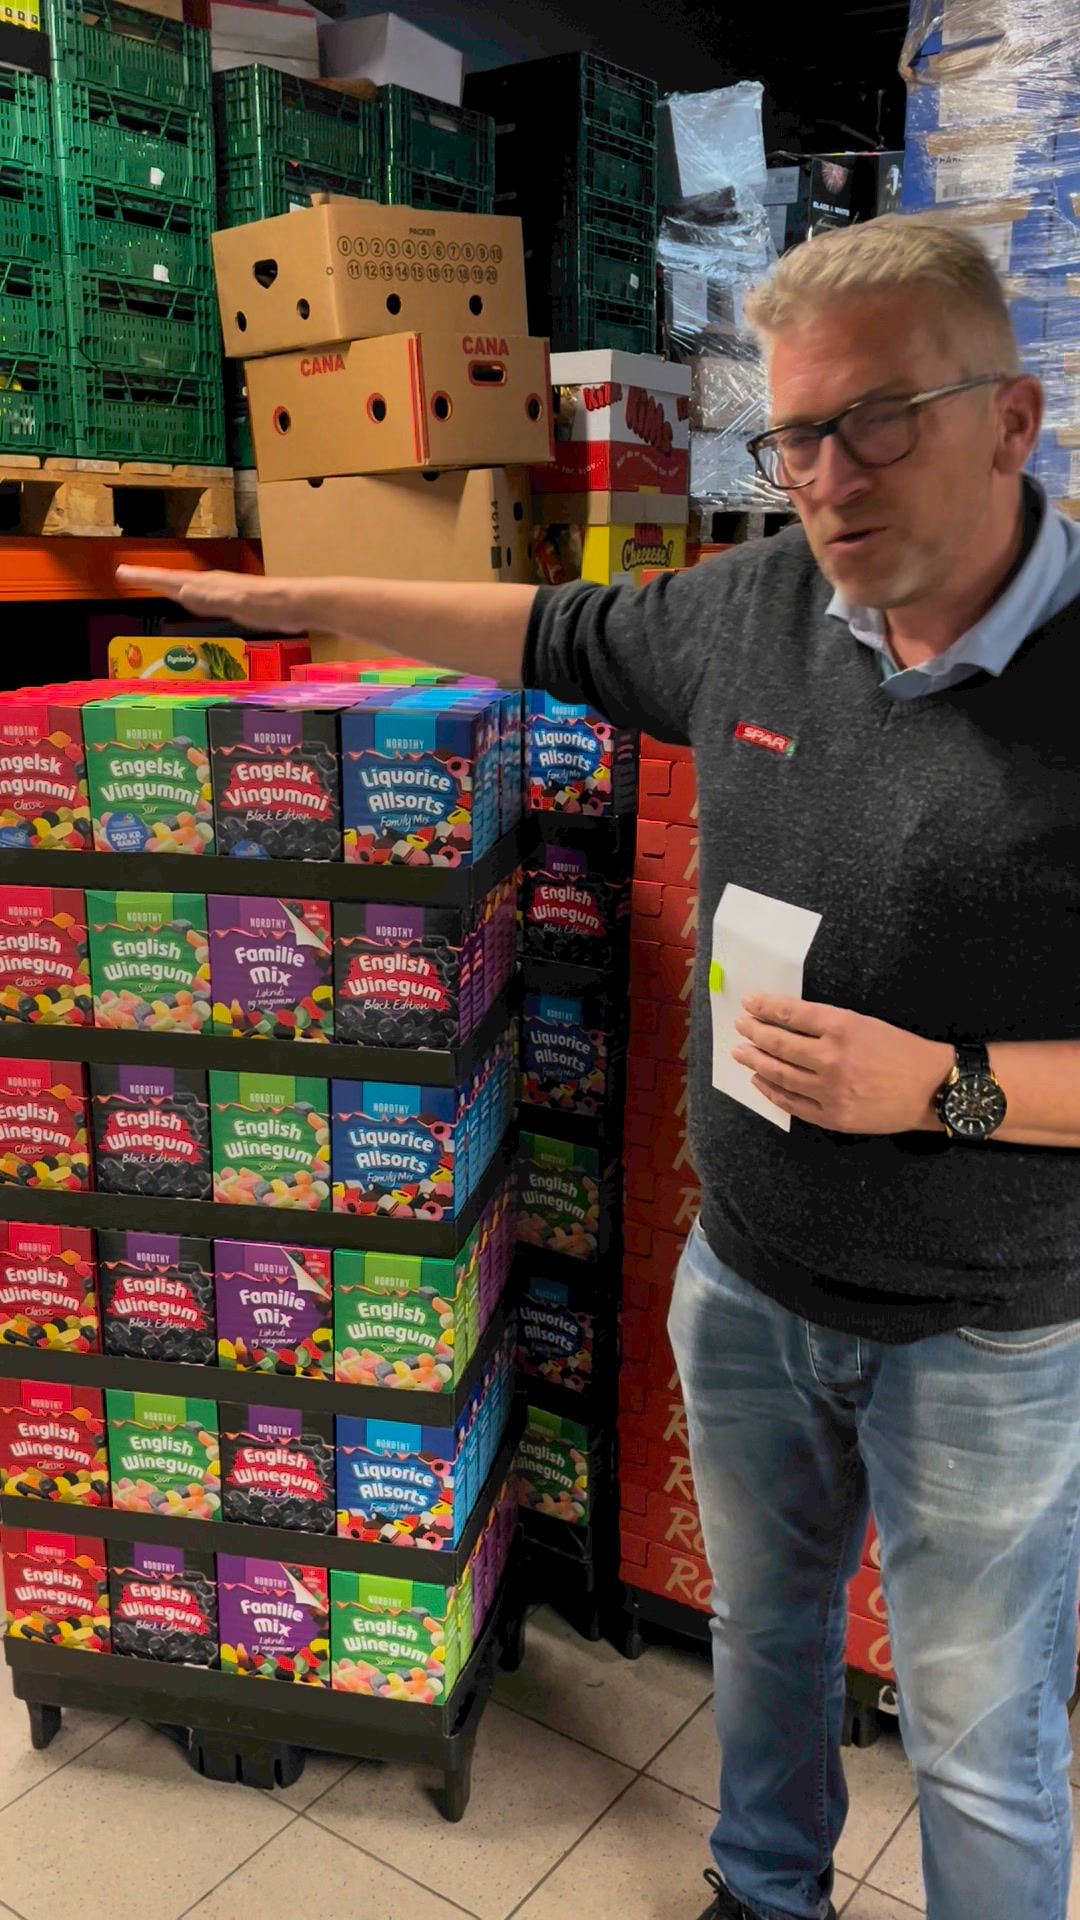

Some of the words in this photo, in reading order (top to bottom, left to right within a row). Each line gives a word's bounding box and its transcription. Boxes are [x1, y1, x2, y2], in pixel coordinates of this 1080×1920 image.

[409, 227, 436, 236] PACKER
[461, 335, 510, 356] CANA
[300, 353, 346, 377] CANA
[534, 730, 597, 751] Liquorice
[743, 727, 787, 750] SPAR
[0, 753, 62, 776] ngelsk
[110, 757, 187, 781] Engelsk
[236, 761, 315, 784] Engelsk
[539, 751, 592, 771] Allsorts
[0, 778, 77, 801] ngummi
[361, 768, 451, 792] Liquorice
[14, 798, 45, 811] Classic
[100, 782, 200, 806] Vingummi
[226, 787, 329, 812] Vingummi
[368, 791, 445, 815] Allsorts
[141, 803, 158, 815] Sur
[246, 810, 273, 821] Black
[275, 808, 311, 821] Edition
[380, 815, 411, 831] Family
[413, 815, 430, 825] Mix
[111, 832, 127, 841] 500
[540, 886, 592, 907] English
[532, 905, 600, 929] Winegum
[112, 938, 182, 960] English
[234, 945, 305, 967] Familie
[103, 961, 193, 985] Winegum
[250, 966, 292, 987] Mix
[358, 953, 431, 977] English
[16, 976, 46, 987] Classic
[138, 982, 158, 993] Sour
[347, 976, 442, 1002] Winegum
[364, 998, 390, 1010] Black
[393, 998, 429, 1010] Edition
[530, 1030, 591, 1055] Liquorice
[535, 1050, 586, 1073] Allsorts
[115, 1110, 182, 1131] English
[234, 1120, 302, 1141] English
[0, 1123, 71, 1147] inegum
[106, 1132, 194, 1156] Winegum
[349, 1129, 434, 1153] Liquorice
[14, 1144, 45, 1155] Classic
[122, 1153, 147, 1163] Black
[149, 1152, 182, 1164] Edition
[224, 1141, 313, 1166] Winegum
[258, 1161, 278, 1172] Sour
[356, 1150, 427, 1173] Allsorts
[366, 1171, 396, 1187] Family
[397, 1172, 414, 1182] Mix
[529, 1173, 578, 1199] English
[521, 1191, 585, 1220] Winegum
[5, 1267, 69, 1288] English
[122, 1277, 187, 1299] English
[0, 1286, 80, 1311] Winegum
[114, 1298, 198, 1322] Winegum
[239, 1289, 306, 1311] Familie
[129, 1318, 153, 1329] Black
[154, 1318, 187, 1329] Edition
[253, 1308, 294, 1328] Mix
[357, 1302, 426, 1325] English
[520, 1306, 578, 1336] Liquorice
[347, 1323, 436, 1349] Winegum
[524, 1326, 574, 1352] Allsorts
[381, 1343, 401, 1354] Sour
[18, 1422, 80, 1443] English
[10, 1441, 90, 1466] Winegum
[130, 1436, 193, 1457] English
[519, 1440, 566, 1468] English
[121, 1455, 204, 1479] Winegum
[242, 1448, 308, 1469] English
[234, 1467, 320, 1493] Winegum
[353, 1462, 435, 1487] Liquorice
[249, 1487, 273, 1498] Black
[360, 1482, 427, 1506] Allsorts
[369, 1502, 398, 1518] Family
[22, 1567, 83, 1589] English
[15, 1587, 94, 1611] Winegum
[130, 1582, 191, 1604] English
[121, 1602, 202, 1627] Winegum
[240, 1600, 304, 1622] Familie
[253, 1617, 292, 1638] Mix
[352, 1617, 418, 1642] English
[342, 1637, 428, 1664] Winegum
[375, 1656, 395, 1667] Sour
